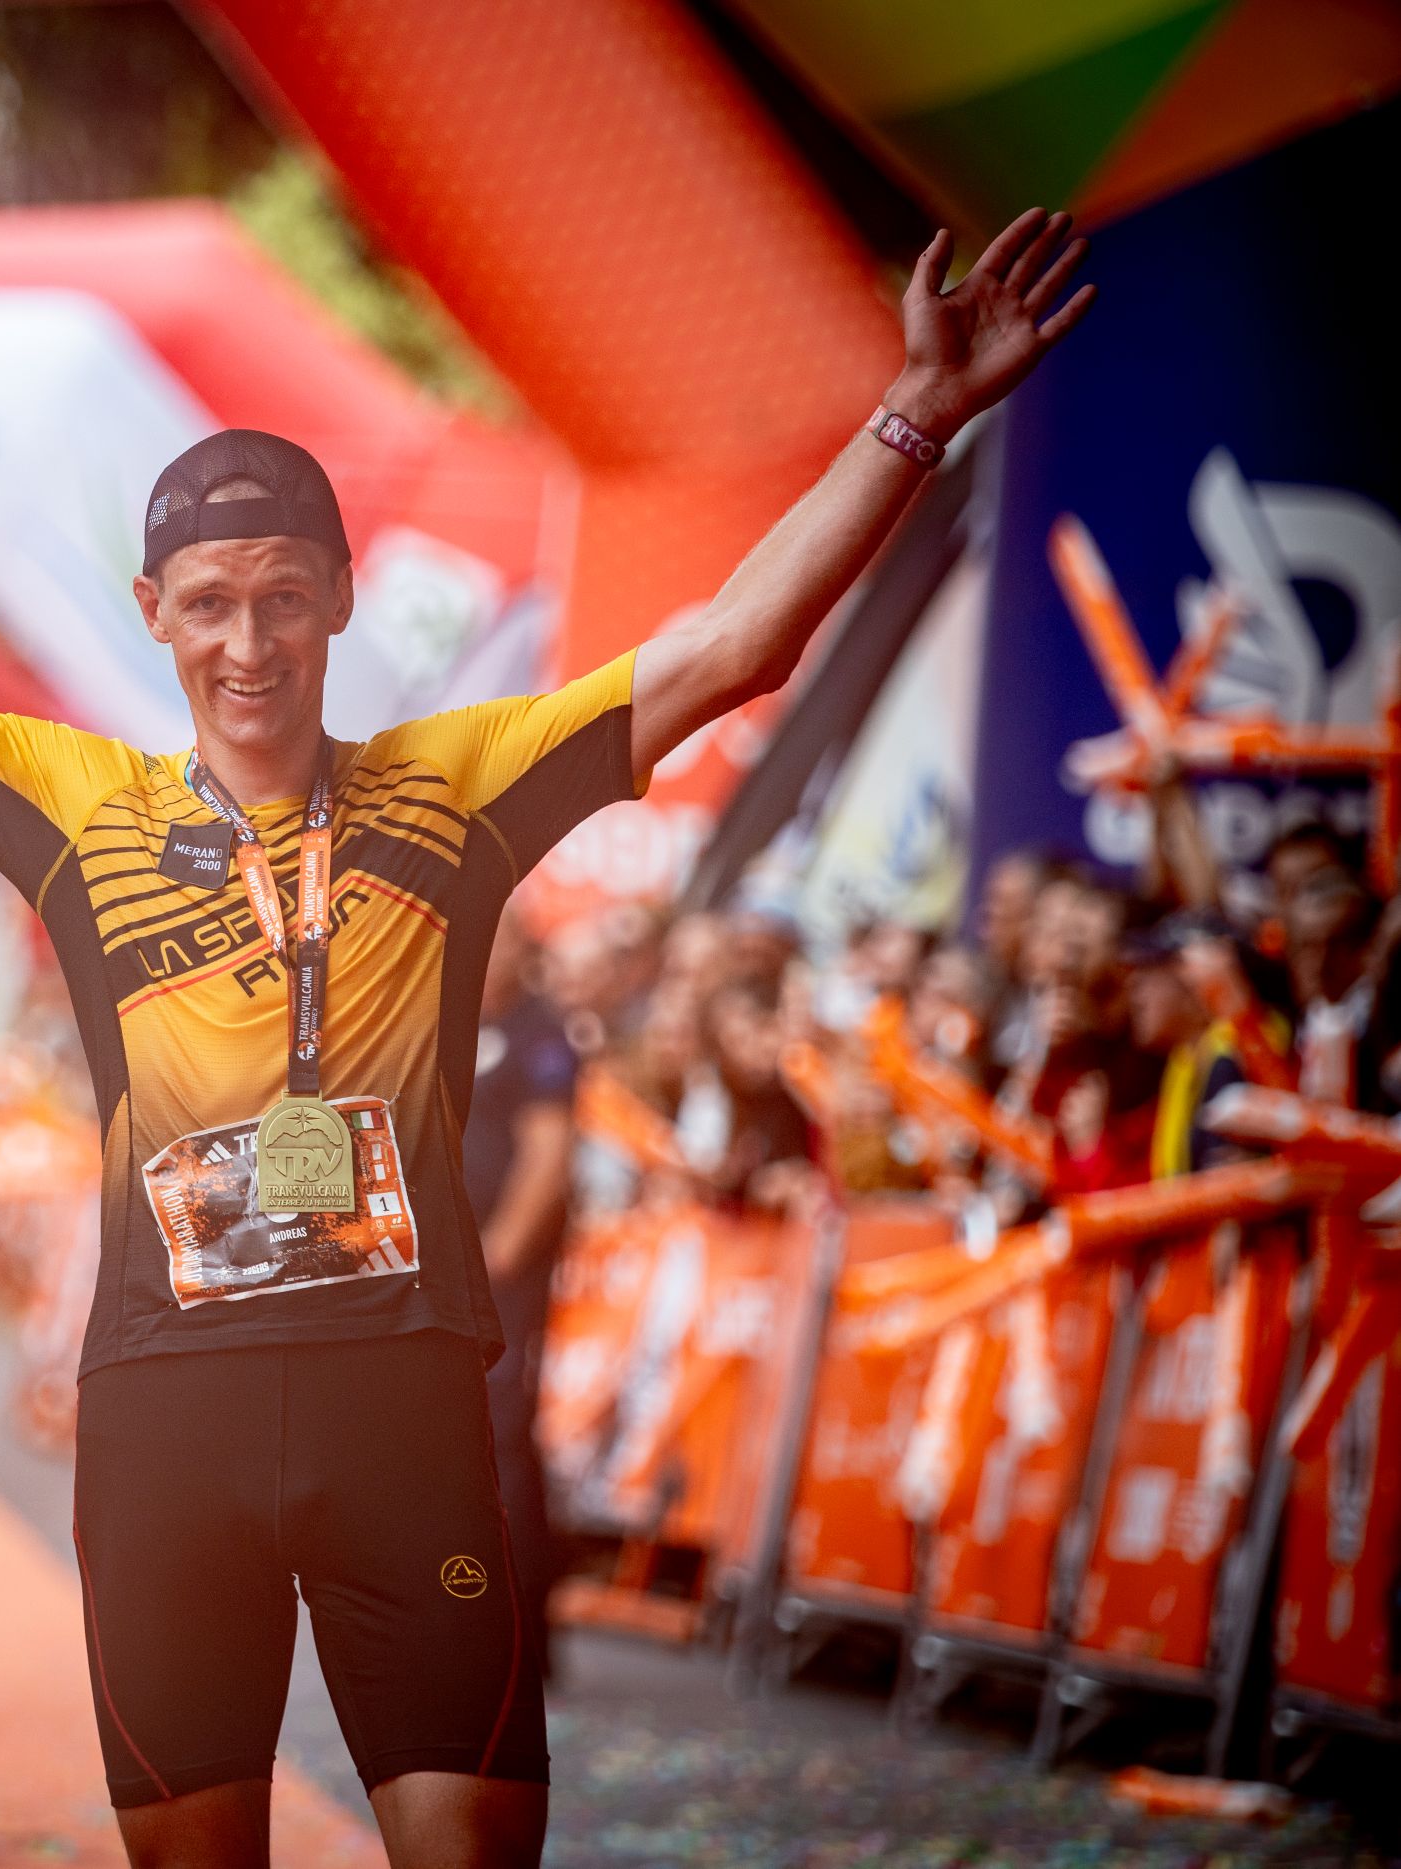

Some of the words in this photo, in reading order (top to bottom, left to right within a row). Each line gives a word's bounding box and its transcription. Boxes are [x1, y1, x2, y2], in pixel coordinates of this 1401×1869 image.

[174, 842, 223, 859] MERANO
[192, 859, 221, 871] 2000
[303, 850, 317, 922] TRANSVULCANIA
[245, 865, 276, 937] TRANSVULCANIA
[137, 939, 193, 979] LA
[299, 966, 313, 1041] TRANSVULCANIA
[310, 1007, 318, 1032] TERREX
[266, 1148, 343, 1183] TRV
[265, 1185, 350, 1198] TRANSVULCANIA
[278, 1199, 305, 1208] TERREX
[379, 1196, 390, 1212] 1
[269, 1226, 308, 1244] ANDREAS
